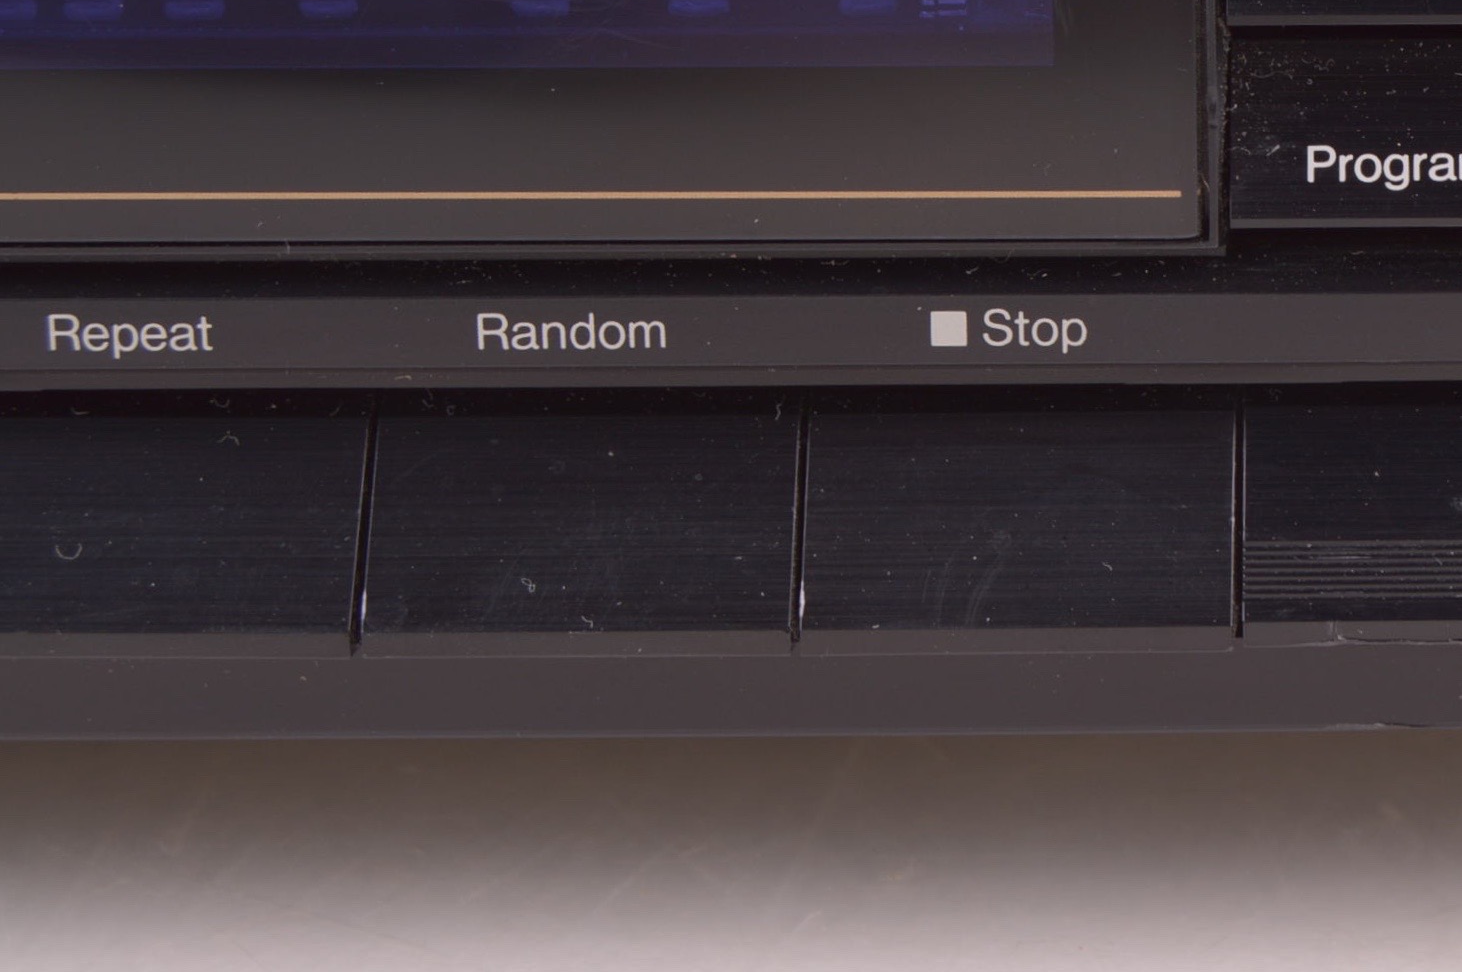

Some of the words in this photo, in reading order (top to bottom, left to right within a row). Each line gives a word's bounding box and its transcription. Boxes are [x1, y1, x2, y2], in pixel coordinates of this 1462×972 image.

[47, 313, 214, 360] Repeat
[476, 312, 667, 351] Random
[982, 307, 1088, 355] Stop
